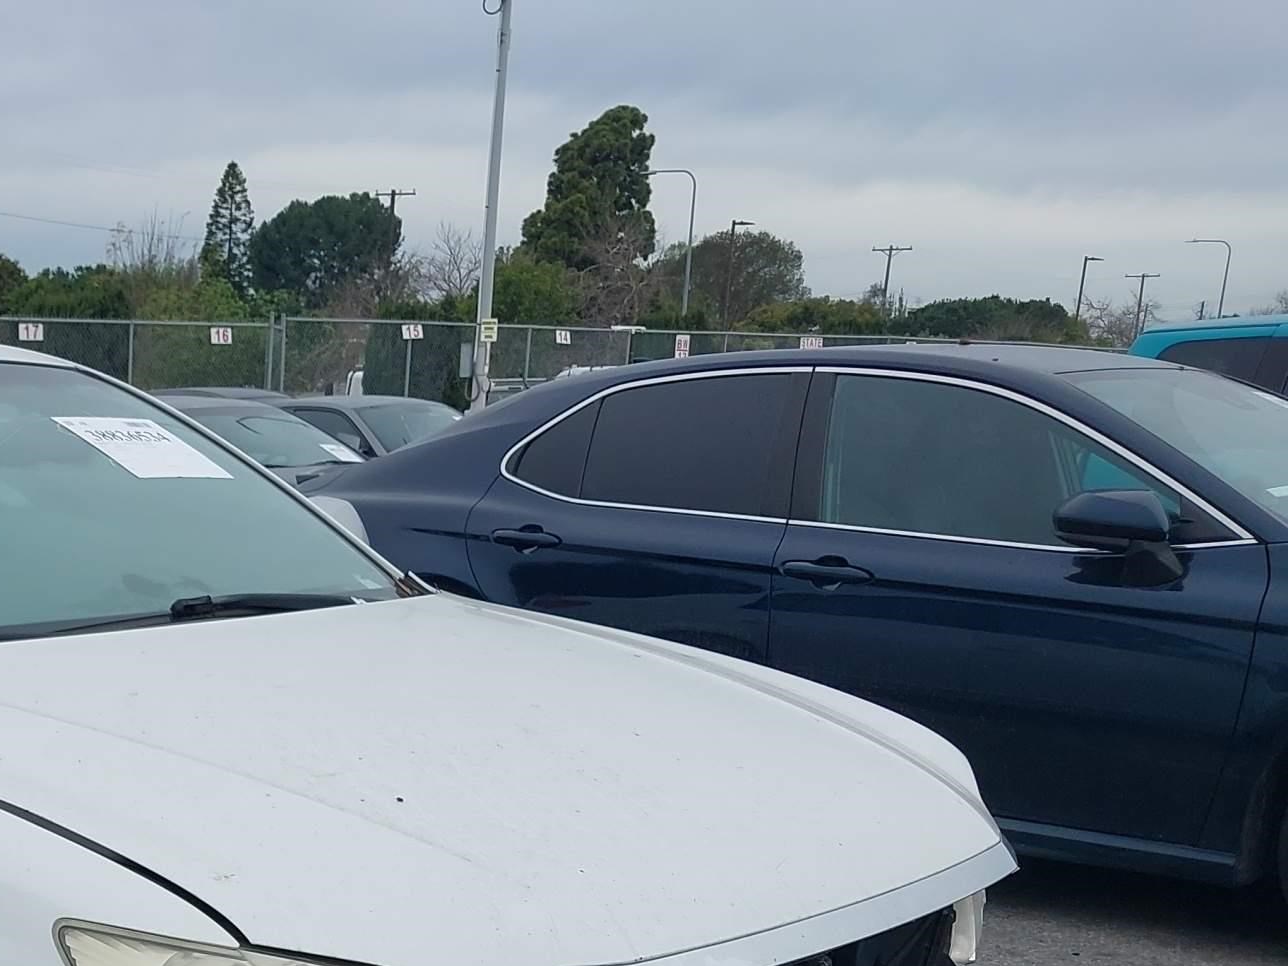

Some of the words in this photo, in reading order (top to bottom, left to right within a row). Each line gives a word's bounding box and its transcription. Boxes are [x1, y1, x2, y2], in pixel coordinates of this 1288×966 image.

[24, 324, 39, 339] 17
[216, 328, 229, 343] 16
[407, 325, 420, 338] 15
[558, 330, 568, 342] 14
[84, 429, 171, 442] 38836534
